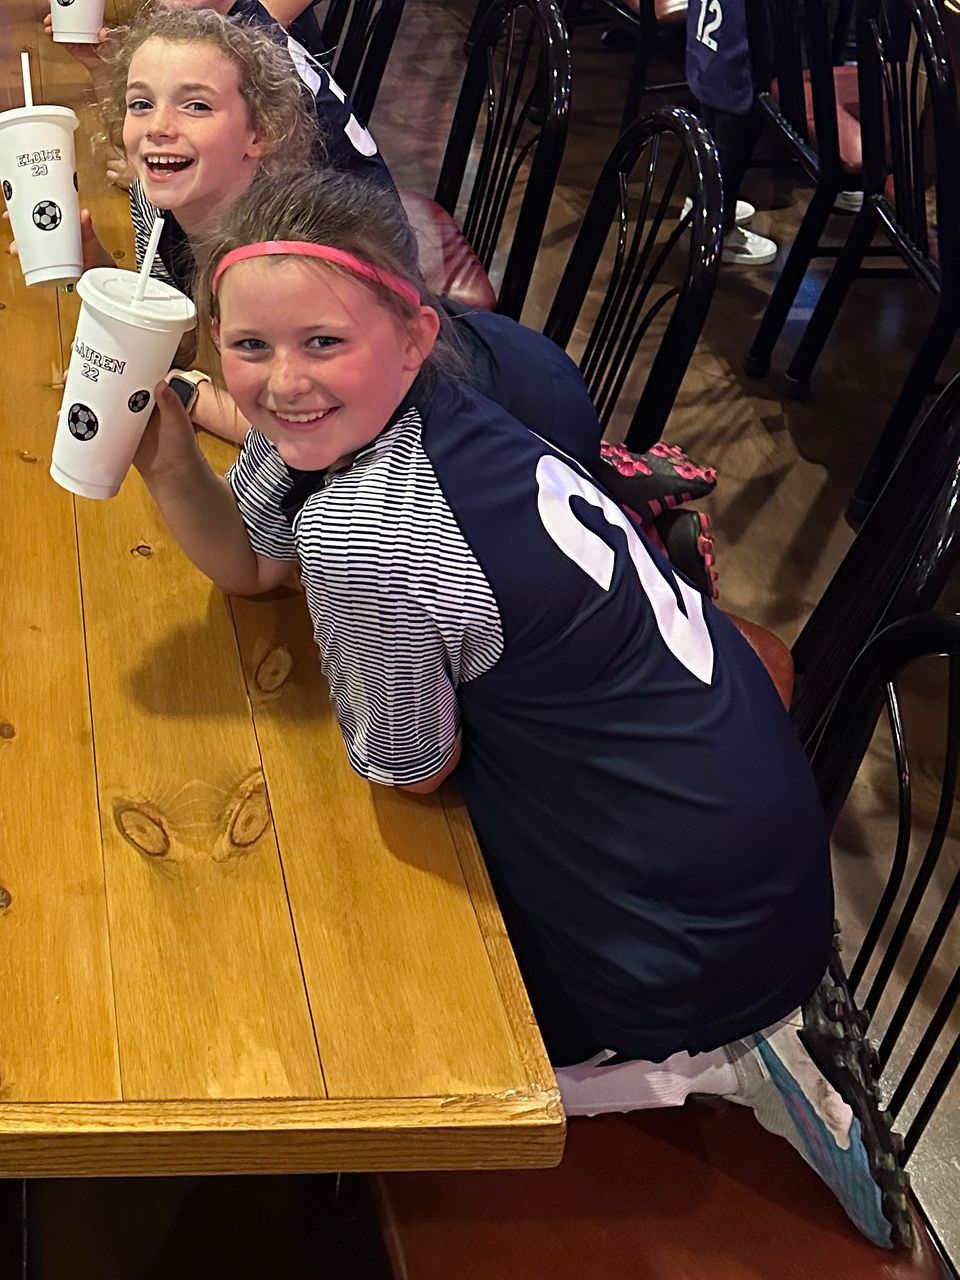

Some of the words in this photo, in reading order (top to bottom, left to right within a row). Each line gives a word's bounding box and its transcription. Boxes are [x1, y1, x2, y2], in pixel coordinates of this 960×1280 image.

[16, 149, 62, 167] ELOISE
[31, 164, 48, 177] 23
[81, 363, 100, 382] 22
[528, 428, 715, 686] 2
